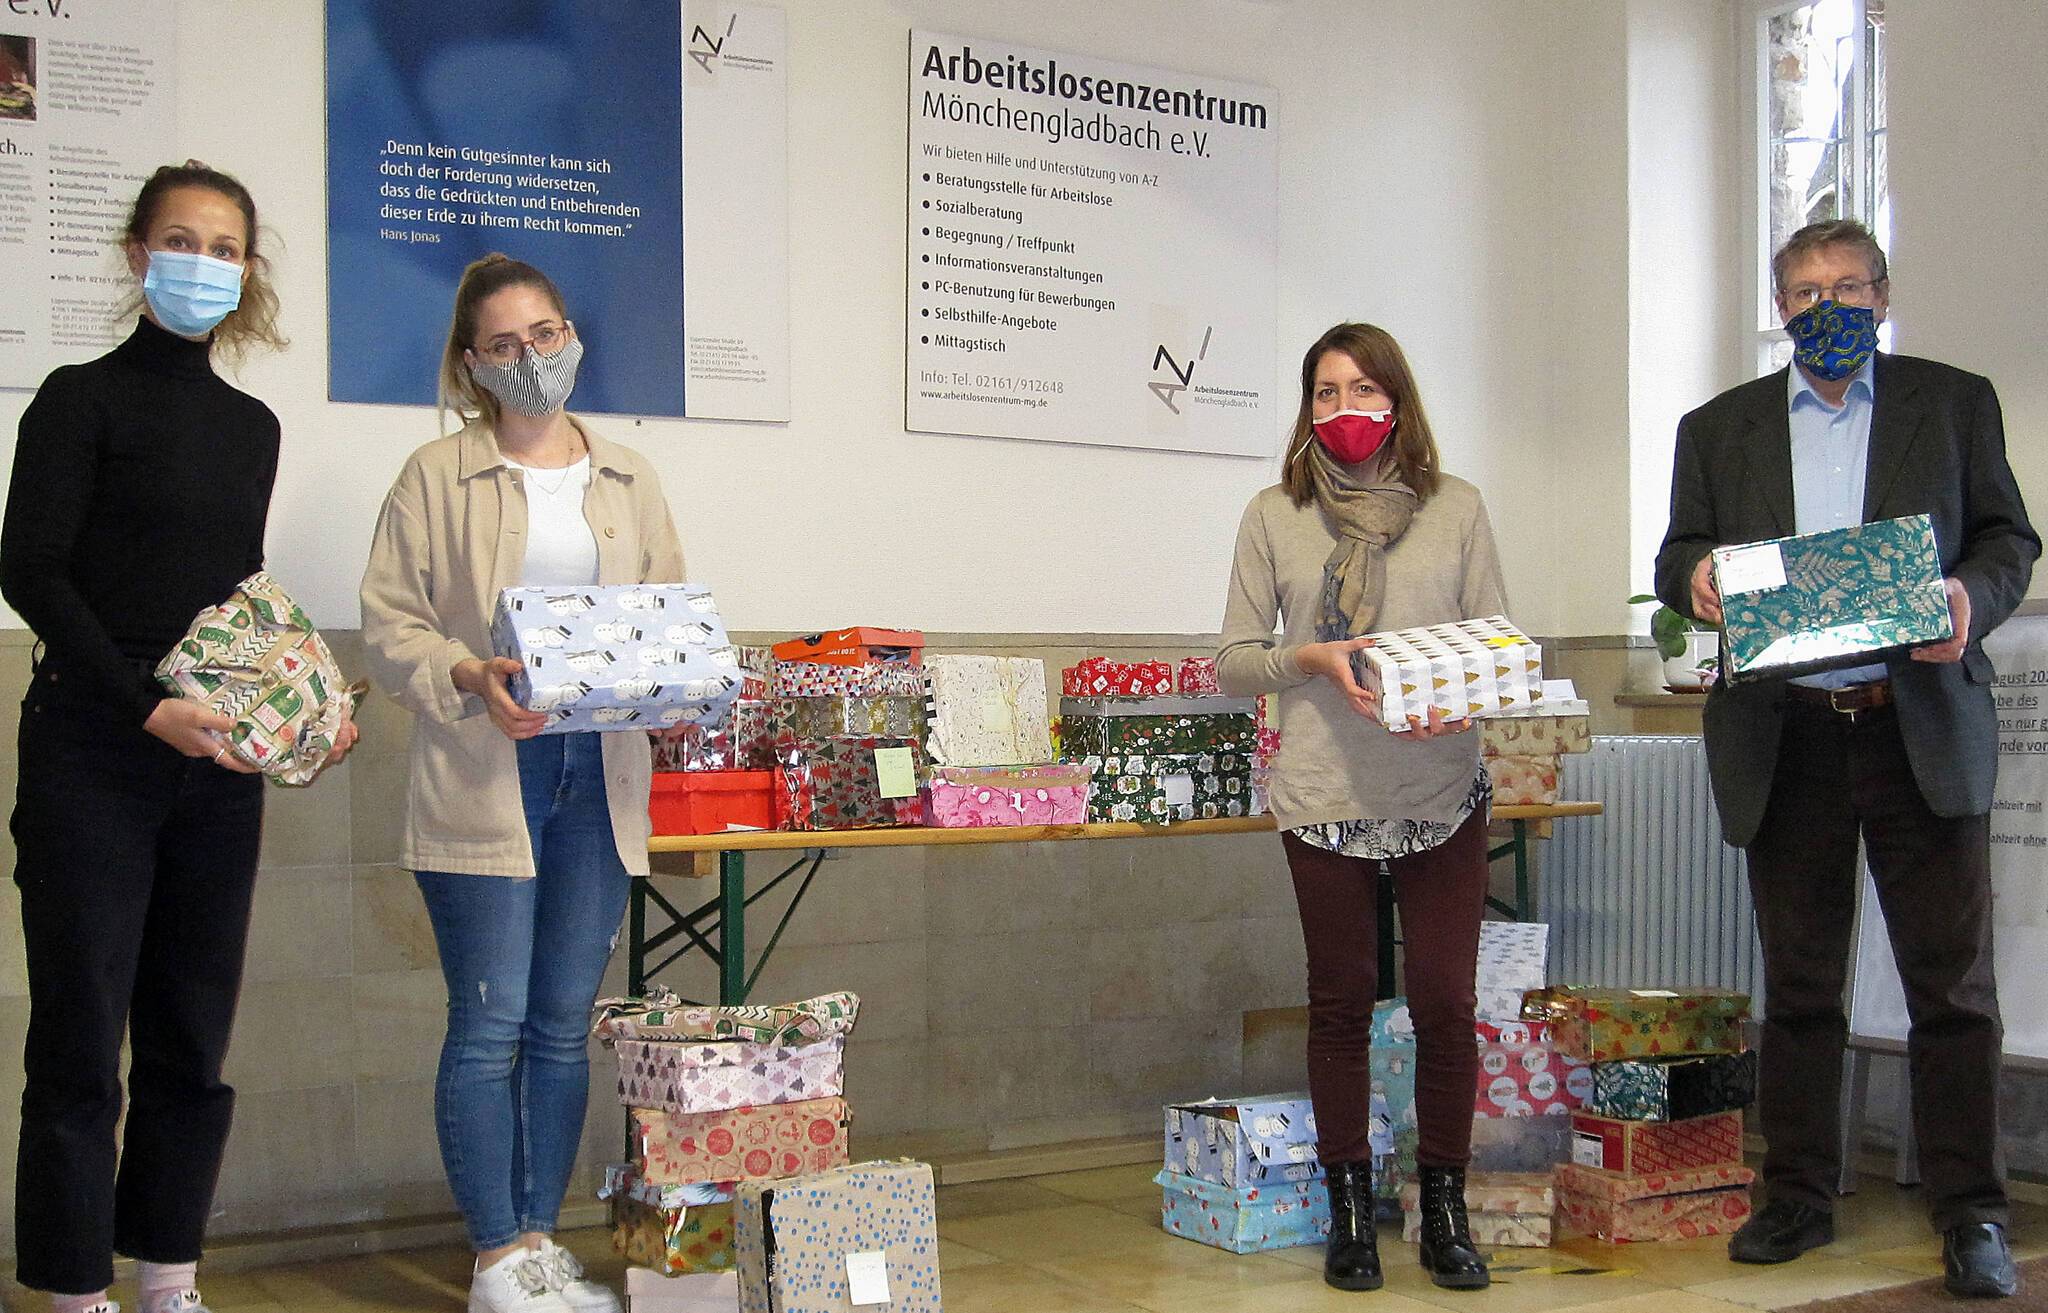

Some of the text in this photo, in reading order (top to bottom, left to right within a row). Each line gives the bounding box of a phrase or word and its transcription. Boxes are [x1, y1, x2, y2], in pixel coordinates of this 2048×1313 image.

[922, 46, 1267, 129] Arbeitslosenzentrum
[922, 90, 1210, 158] Mönchengladbach e.V.
[428, 142, 457, 159] kein
[461, 147, 546, 167] Gutgesinnter
[550, 154, 582, 171] kann
[586, 158, 611, 173] sich
[923, 143, 1159, 187] Wir bieten Hilfe und Unterstützung von A-Z
[380, 160, 600, 195] doch der Forderung widersetzen,
[936, 172, 1113, 206] Beratungsstelle für Arbeitslose
[380, 182, 640, 218] dass die Gedrückten und Entbehrenden
[936, 199, 1023, 225] Sozialberatung
[380, 203, 422, 220] dieser
[427, 208, 457, 223] Erde
[460, 213, 476, 225] zu
[480, 211, 519, 228] ihrem
[524, 216, 560, 232] Recht
[380, 228, 441, 244] Hans Jonas
[936, 226, 1075, 254] Begegnung / Treffpunkt
[935, 253, 1103, 284] Informationsveranstaltungen
[935, 280, 1115, 312] PC-Benutzung für Bewerbungen
[935, 307, 1057, 331] Selbsthilfe-Angebote
[934, 334, 1006, 352] Mittagstisch
[920, 370, 1064, 394] Info: Tel. 02161/912648
[1194, 386, 1259, 398] Arbeitslosenzentrum
[920, 389, 1048, 409] www.arbeitslosenzentrum-mg.de
[2030, 670, 2048, 683] 20
[2017, 694, 2038, 706] des
[2016, 719, 2038, 728] nur
